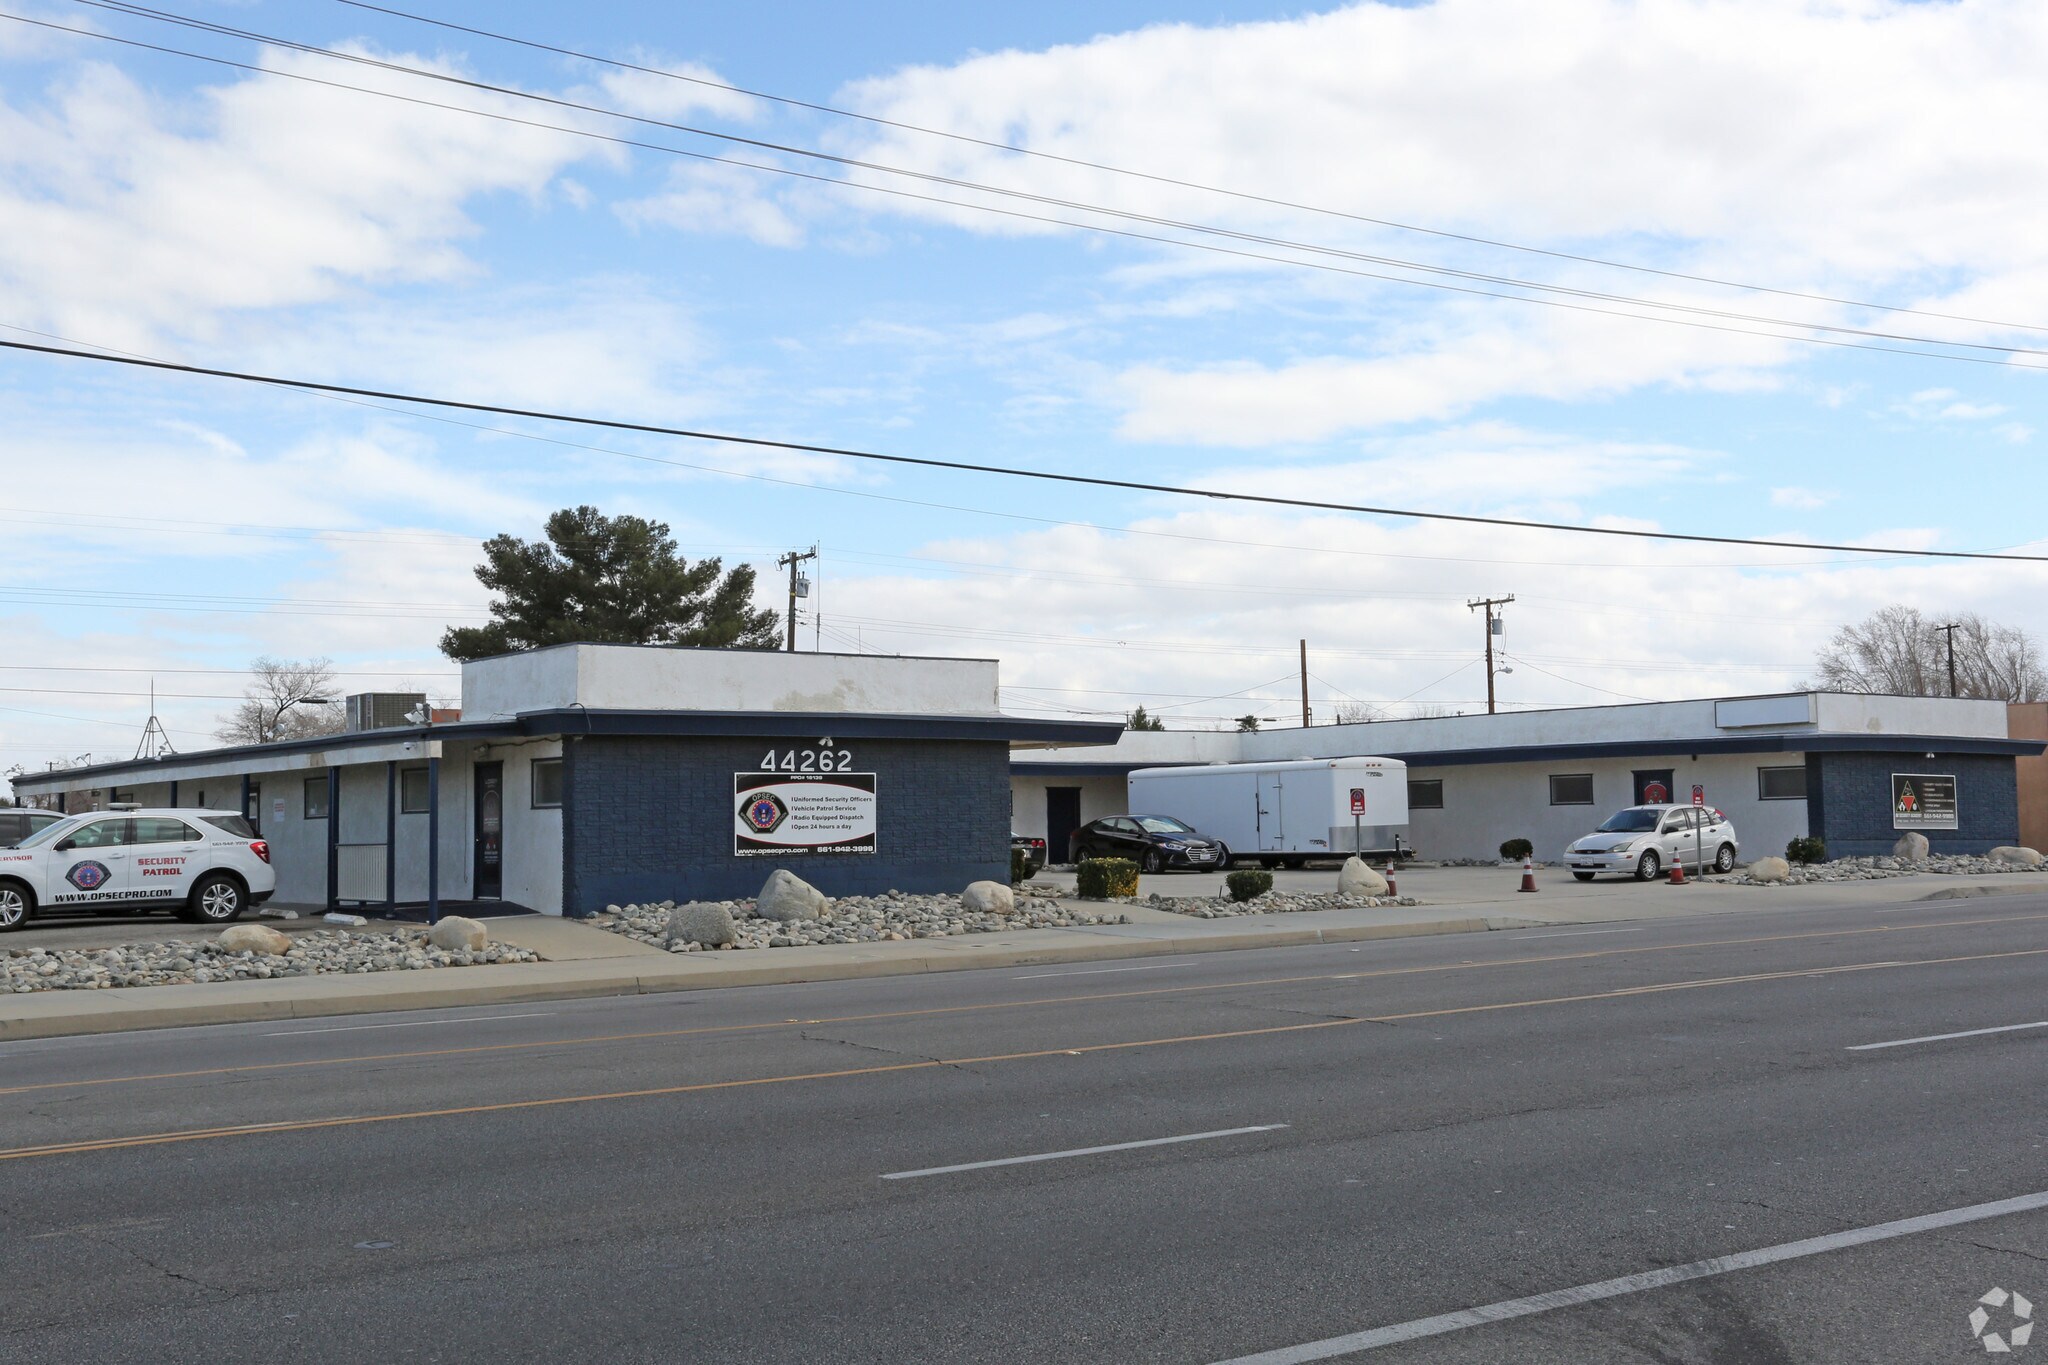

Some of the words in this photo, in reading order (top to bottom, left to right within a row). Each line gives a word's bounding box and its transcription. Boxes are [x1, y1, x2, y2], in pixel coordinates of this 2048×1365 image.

[760, 749, 852, 772] 44262
[752, 792, 776, 802] OPSEC
[738, 847, 809, 855] www.opsecpro.com
[137, 857, 187, 866] SECURITY
[143, 867, 182, 876] PATROL
[55, 889, 172, 902] WWW.OPSECPRO.COM
